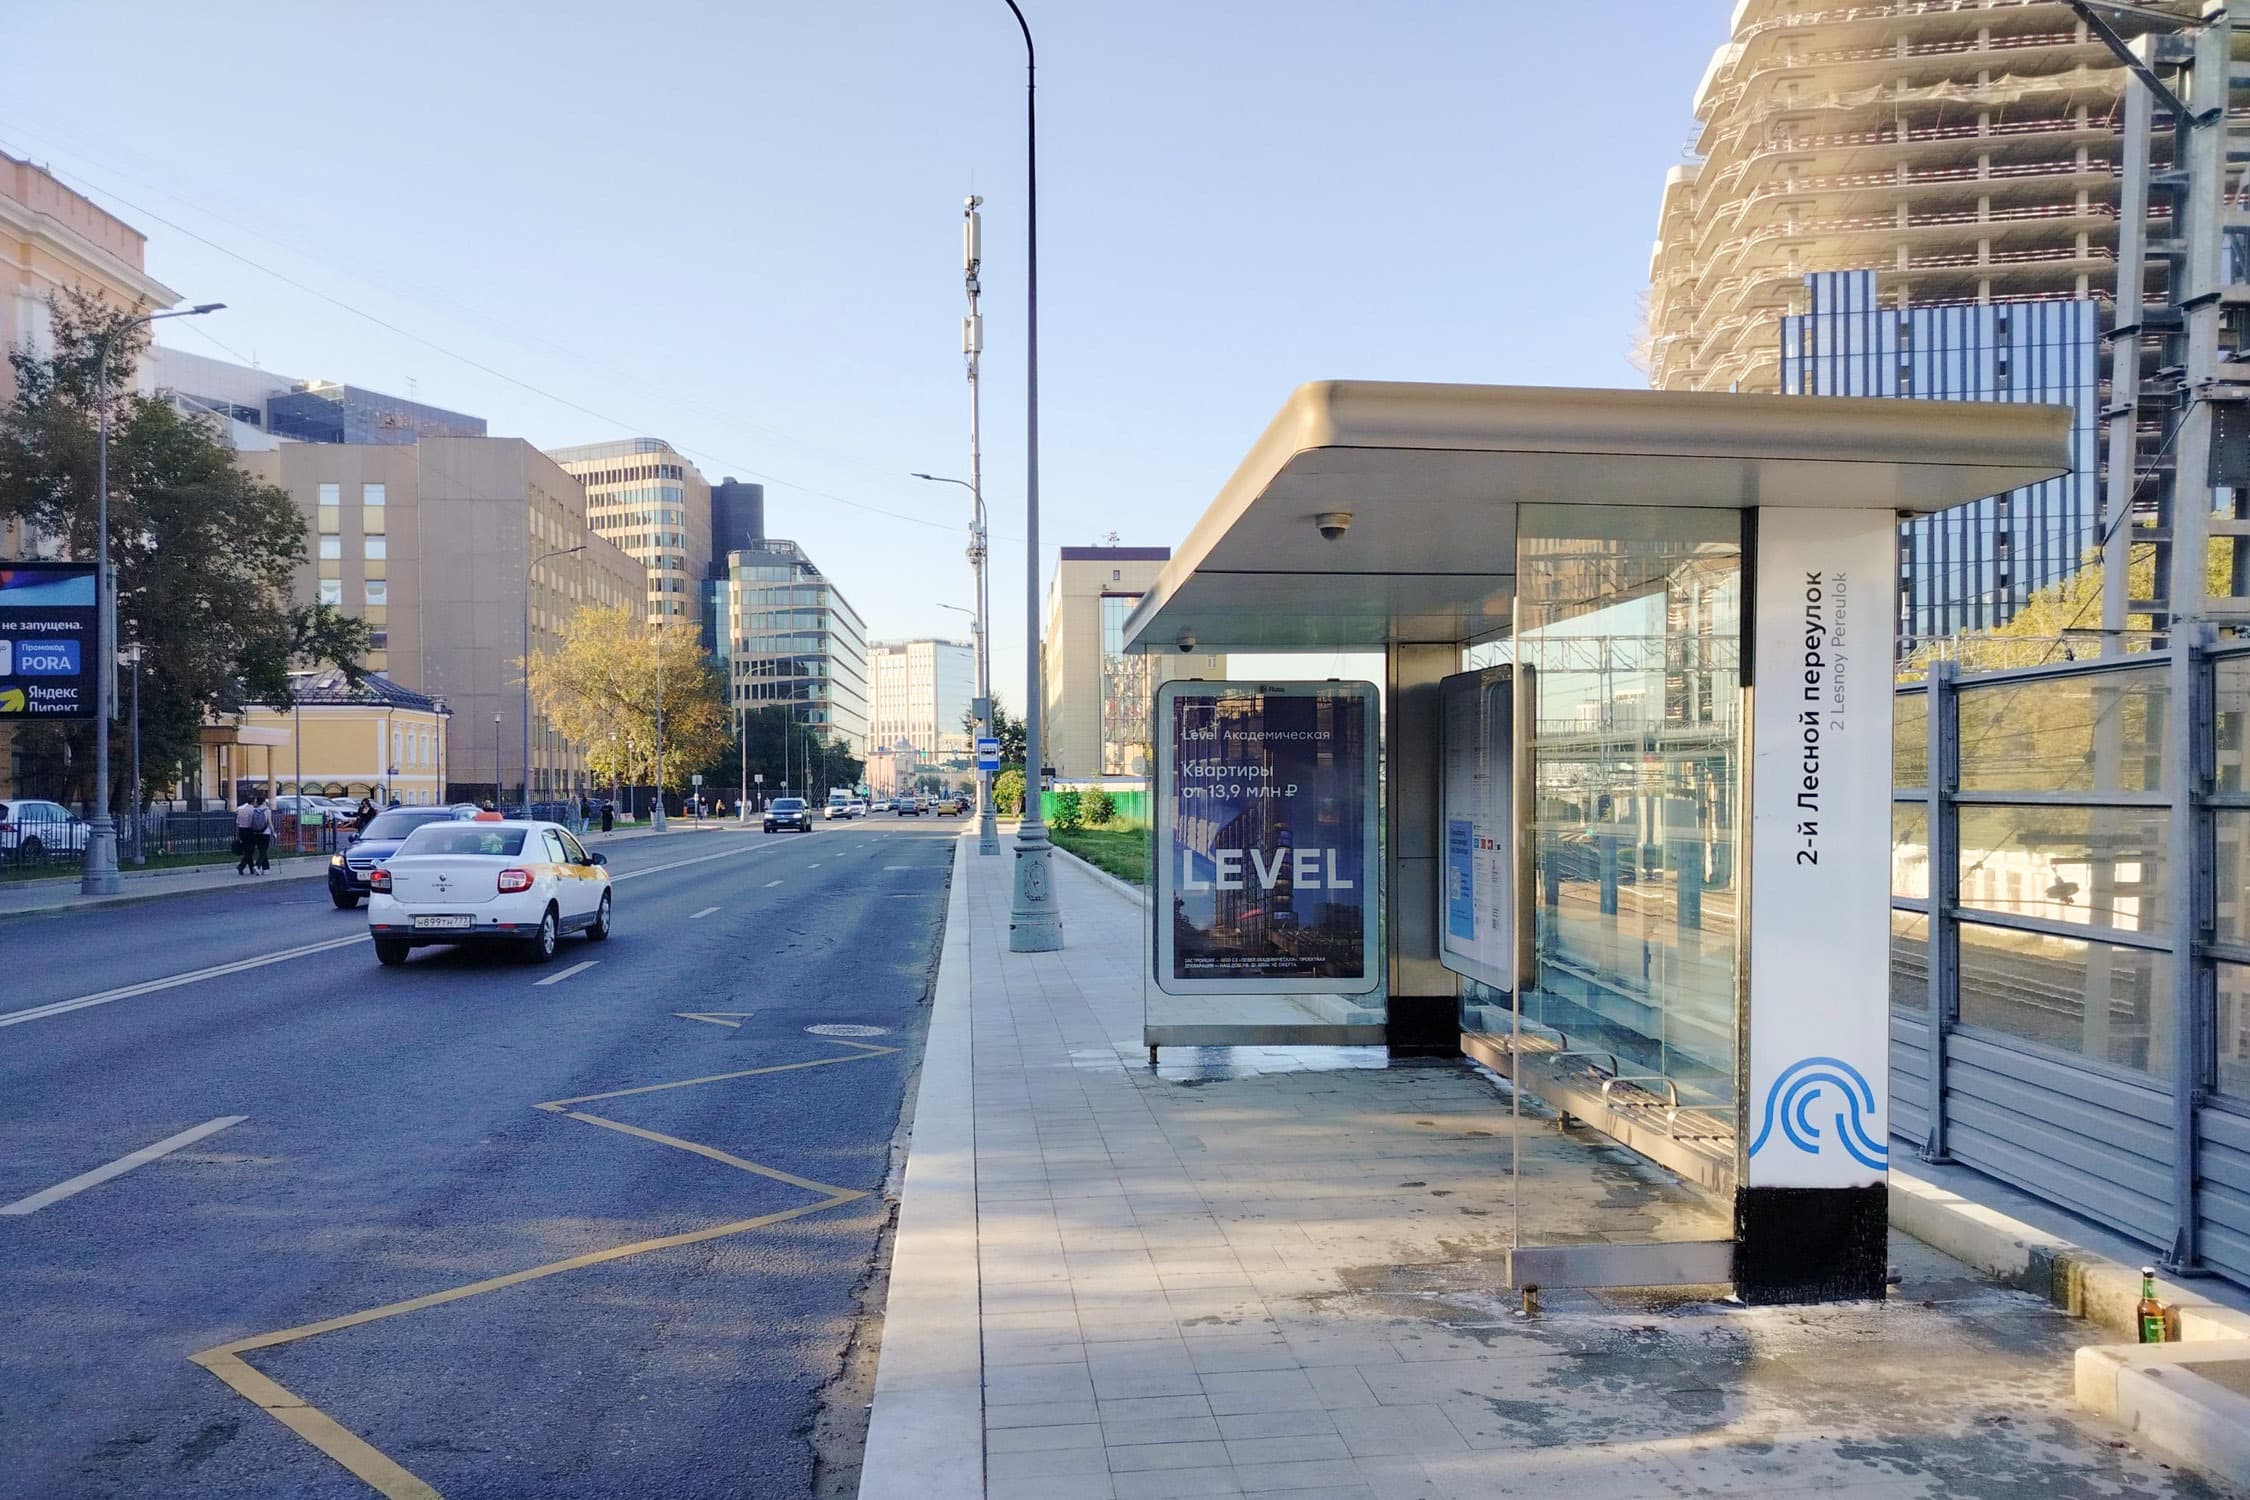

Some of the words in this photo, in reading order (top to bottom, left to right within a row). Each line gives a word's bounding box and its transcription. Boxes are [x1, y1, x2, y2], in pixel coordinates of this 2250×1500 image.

[1831, 572, 1847, 647] Pereulok
[2, 621, 17, 630] не
[20, 621, 84, 632] запущена.
[1804, 571, 1827, 701] переулок
[22, 643, 65, 652] Промокод
[22, 656, 71, 670] PORA
[28, 685, 79, 699] Яндекс
[1830, 653, 1848, 714] Lesnoy
[1830, 720, 1845, 731] 2
[1183, 730, 1217, 741] Level
[1223, 730, 1331, 742] Академическая
[1797, 711, 1820, 812] Лесной
[1183, 764, 1274, 781] Квартиры
[1183, 786, 1206, 799] от
[1208, 784, 1241, 801] 13,9
[1246, 786, 1281, 798] млн
[1796, 821, 1818, 865] 2-й
[1183, 848, 1354, 891] LEVEL
